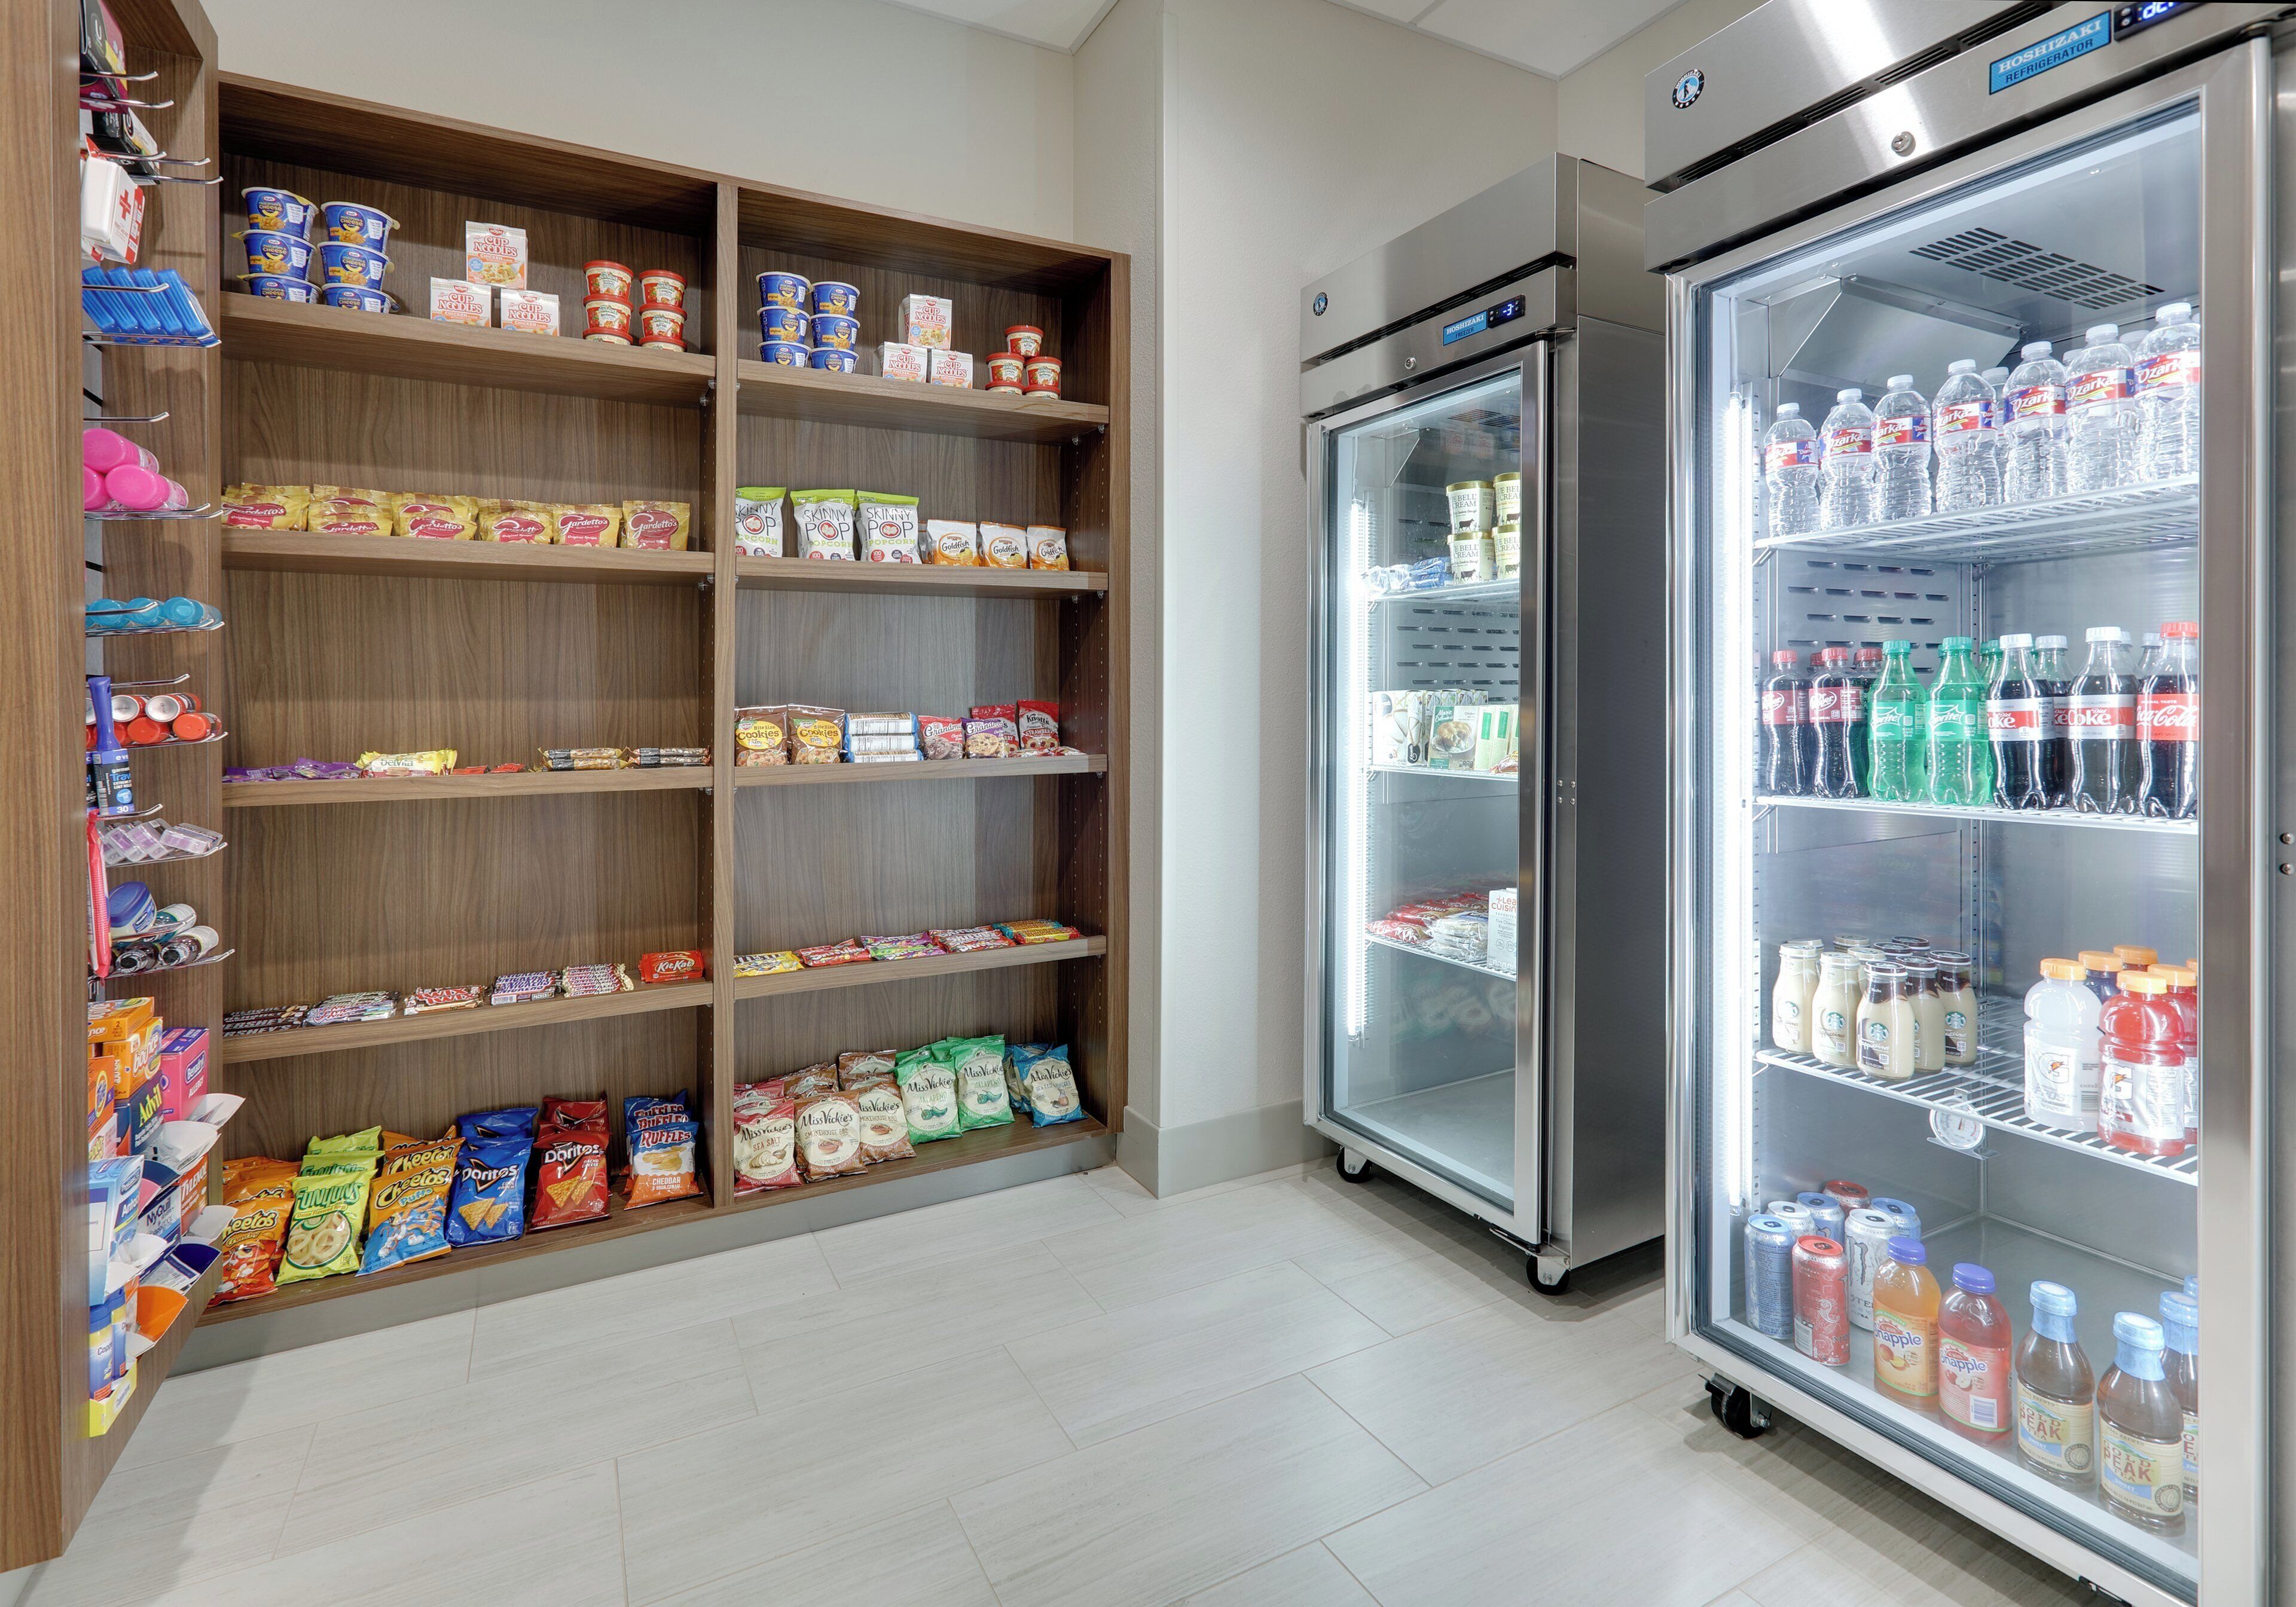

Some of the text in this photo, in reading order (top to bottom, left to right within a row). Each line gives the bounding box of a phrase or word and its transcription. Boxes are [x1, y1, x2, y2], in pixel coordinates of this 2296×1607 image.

[1998, 20, 2102, 74] HOSHIZAKI
[2005, 39, 2093, 84] REFRIGERATOR
[484, 236, 508, 246] CUP
[474, 242, 517, 257] NOODLES
[448, 293, 474, 303] CUP
[438, 300, 483, 314] NOODLES
[518, 303, 542, 313] CUP
[923, 306, 940, 316] CUP
[509, 310, 551, 323] NOODLES
[915, 312, 946, 324] NOODLES
[1446, 314, 1485, 335] HOSHIZAKI
[1455, 326, 1474, 339] FREEZER
[889, 360, 921, 372] NOODLES
[897, 355, 915, 364] CUP
[944, 360, 960, 371] CUP
[937, 366, 967, 377] NOODLES
[2066, 375, 2117, 401] Ozarka
[2010, 391, 2057, 413] Ozarka
[804, 508, 846, 523] SKINNY
[867, 508, 911, 521] SKINNY
[558, 515, 608, 534] Gardetto's
[630, 513, 677, 538] Gardetto's
[805, 520, 850, 541] POP
[868, 520, 913, 539] POP
[942, 540, 970, 551] Goldfish
[993, 545, 1019, 554] Goldfish
[2068, 709, 2111, 726] Coke
[737, 729, 780, 740] Cookies
[799, 729, 838, 738] Cookies
[1491, 903, 1516, 913] CUISIN
[133, 1032, 159, 1076] bounce
[187, 1055, 206, 1079] Benadryl
[964, 1067, 980, 1078] Miss
[1048, 1065, 1072, 1080] Vickie's
[188, 1076, 204, 1098] ALLERGY
[906, 1083, 928, 1093] Miss
[139, 1084, 163, 1128] Advil
[869, 1097, 900, 1114] Vickie's
[801, 1107, 853, 1129] Miss Vickie's
[639, 1131, 692, 1148] RUFFLES
[740, 1127, 760, 1143] Miss
[805, 1129, 838, 1139] SMOKEHOUSE
[753, 1136, 781, 1152] SEA SALT
[544, 1144, 601, 1165] Doritos
[182, 1162, 207, 1201] TYLENOL
[462, 1165, 519, 1183] Doritos
[652, 1177, 681, 1186] CHEDDAR
[295, 1181, 363, 1209] FUNYUNS
[375, 1166, 451, 1209] Cheetos
[399, 1187, 433, 1207] Puffs
[146, 1196, 172, 1226] NyQuil
[312, 1208, 334, 1217] Flavored
[222, 1209, 278, 1240] heetos
[226, 1232, 262, 1247] Crunchy
[1874, 1320, 1922, 1349] Snapple
[1940, 1349, 1987, 1374] Snapple
[2020, 1401, 2061, 1427] GOLD
[2020, 1408, 2062, 1441] PEAK
[2028, 1426, 2047, 1441] TEA
[2028, 1437, 2047, 1449] SWEET
[2103, 1440, 2151, 1468] GOLD
[2104, 1447, 2152, 1483] PEAK
[2112, 1467, 2136, 1483] TEA
[2113, 1477, 2135, 1492] SWEET
